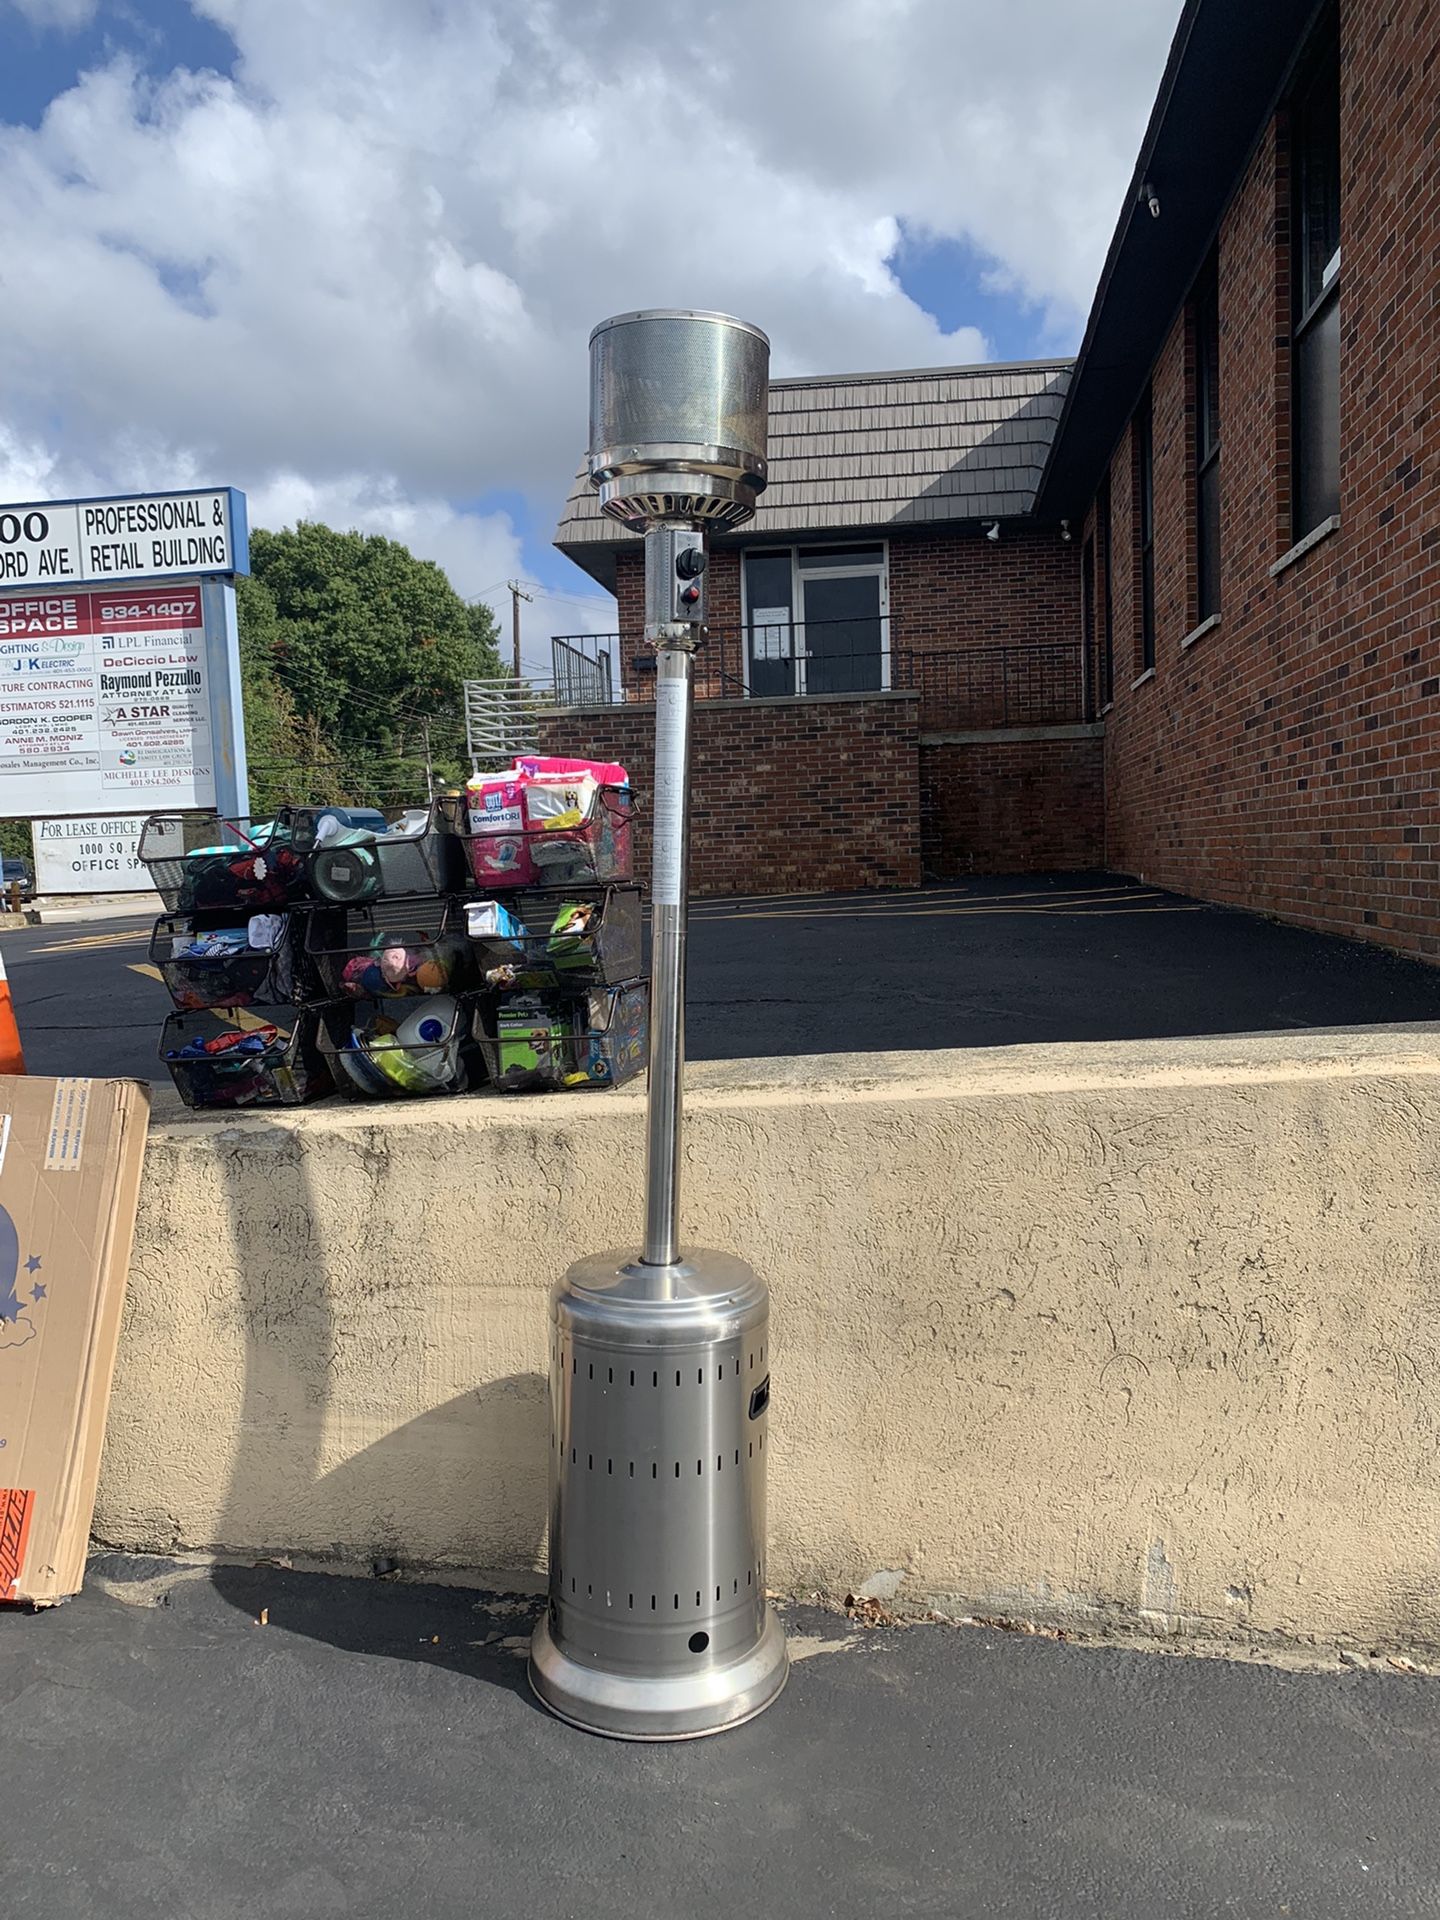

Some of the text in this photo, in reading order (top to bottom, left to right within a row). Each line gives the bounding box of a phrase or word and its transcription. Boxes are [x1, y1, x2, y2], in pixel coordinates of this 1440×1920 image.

[85, 498, 224, 536] PROFESSIONAL &
[90, 535, 226, 572] RETAIL BUILDING
[38, 548, 74, 576] AVE.
[0, 599, 77, 618] OFFICE
[101, 601, 196, 620] 934-1407
[0, 616, 78, 634] SPACE
[118, 633, 193, 649] LPL Financial
[13, 660, 22, 671] J
[28, 658, 40, 670] K
[41, 659, 75, 669] ELECTRIC
[103, 654, 198, 668] DeCiccio Law
[27, 679, 93, 692] CONTRACTING
[100, 669, 201, 692] Raymond Pezzullo
[101, 690, 159, 699] ATTORNEY
[177, 687, 202, 695] LAW
[1, 698, 95, 712] ESTIMATORS 521.1115
[117, 705, 170, 719] A STAR
[0, 717, 37, 726] ORDON
[52, 714, 93, 723] COOPER
[4, 734, 84, 745] ANNE M. MONIZ
[22, 759, 67, 768] Management
[85, 756, 99, 765] Inc.
[104, 767, 211, 780] MICHELLE LEE DESIGNS
[40, 821, 63, 838] FOR
[66, 822, 98, 836] LEASE
[100, 820, 138, 835] OFFICE
[79, 843, 103, 855] 1000
[110, 842, 128, 854] SQ.
[72, 858, 119, 872] OFFICE
